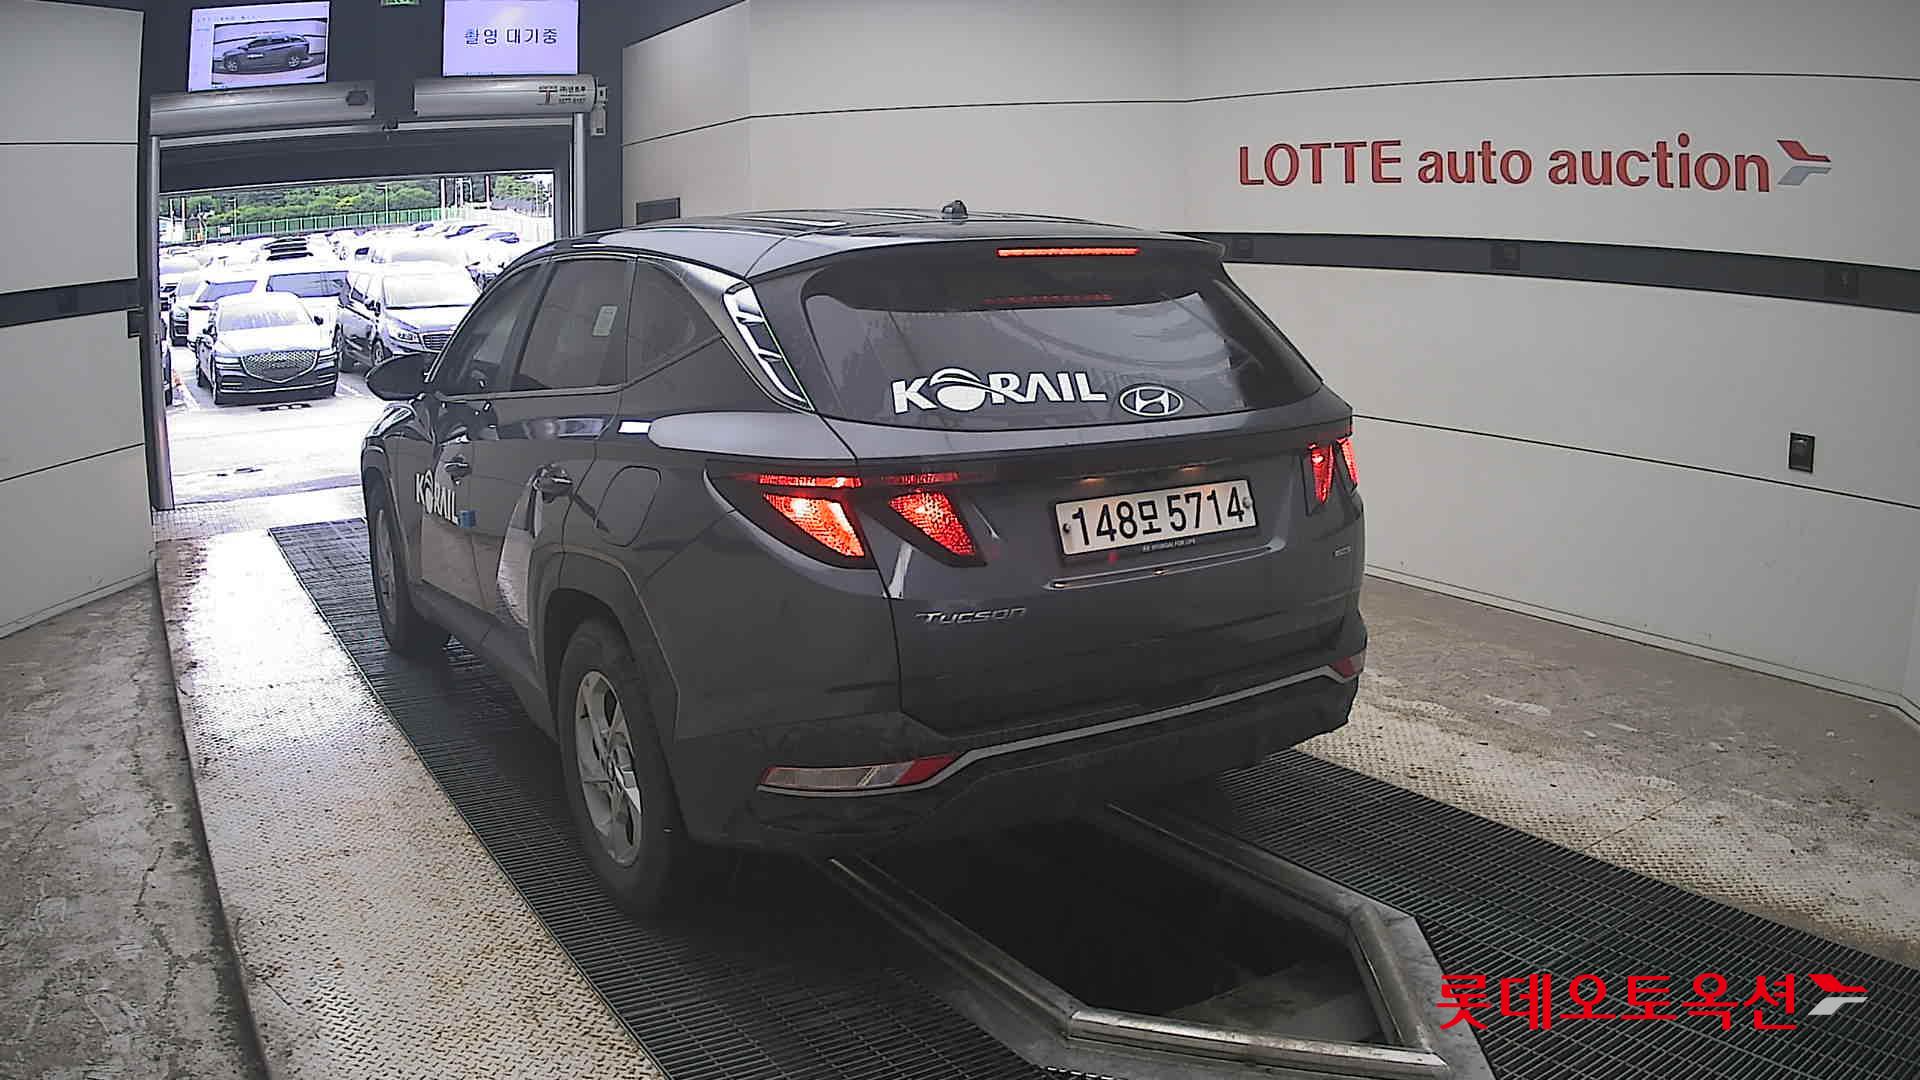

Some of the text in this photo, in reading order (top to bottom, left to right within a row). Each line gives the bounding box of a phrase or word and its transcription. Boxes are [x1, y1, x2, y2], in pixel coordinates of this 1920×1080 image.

[506, 28, 558, 45] 대기중
[1239, 133, 1771, 192] LOTTE auto auction
[891, 367, 1108, 414] KORAIL
[415, 469, 459, 526] KORAIL
[1071, 486, 1245, 546] 148모 5714
